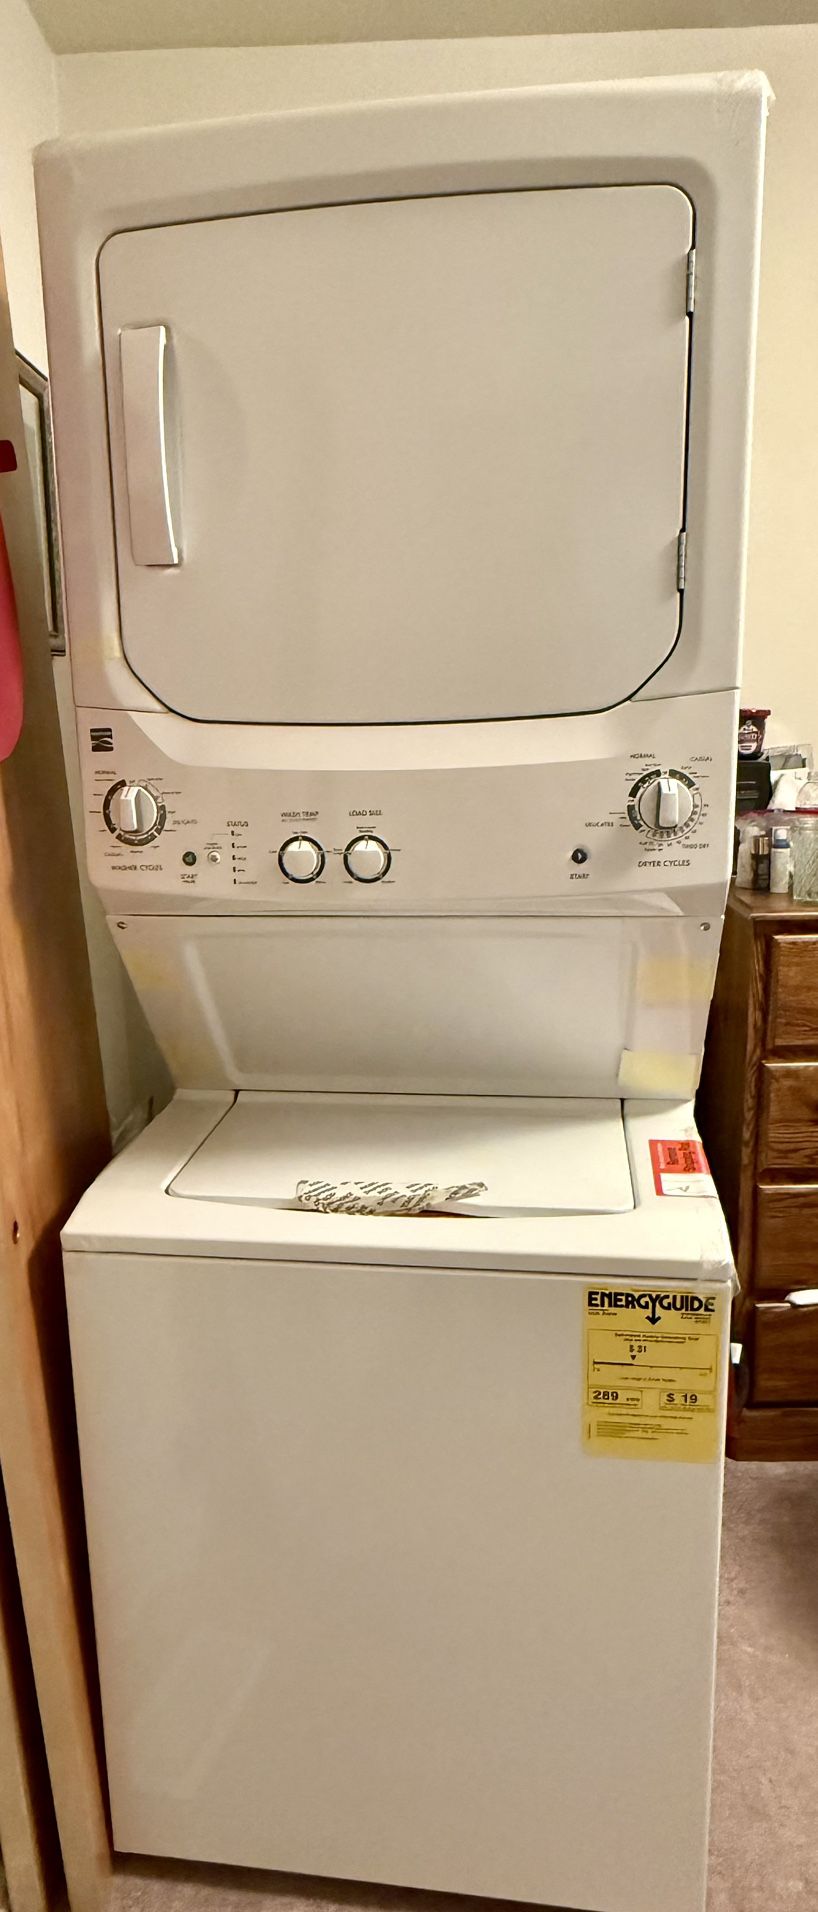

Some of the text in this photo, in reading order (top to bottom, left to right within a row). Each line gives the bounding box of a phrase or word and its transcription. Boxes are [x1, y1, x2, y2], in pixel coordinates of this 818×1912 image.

[588, 1290, 717, 1313] ENERGYGUIDE
[592, 1390, 619, 1401] 289
[683, 1393, 698, 1404] 19
